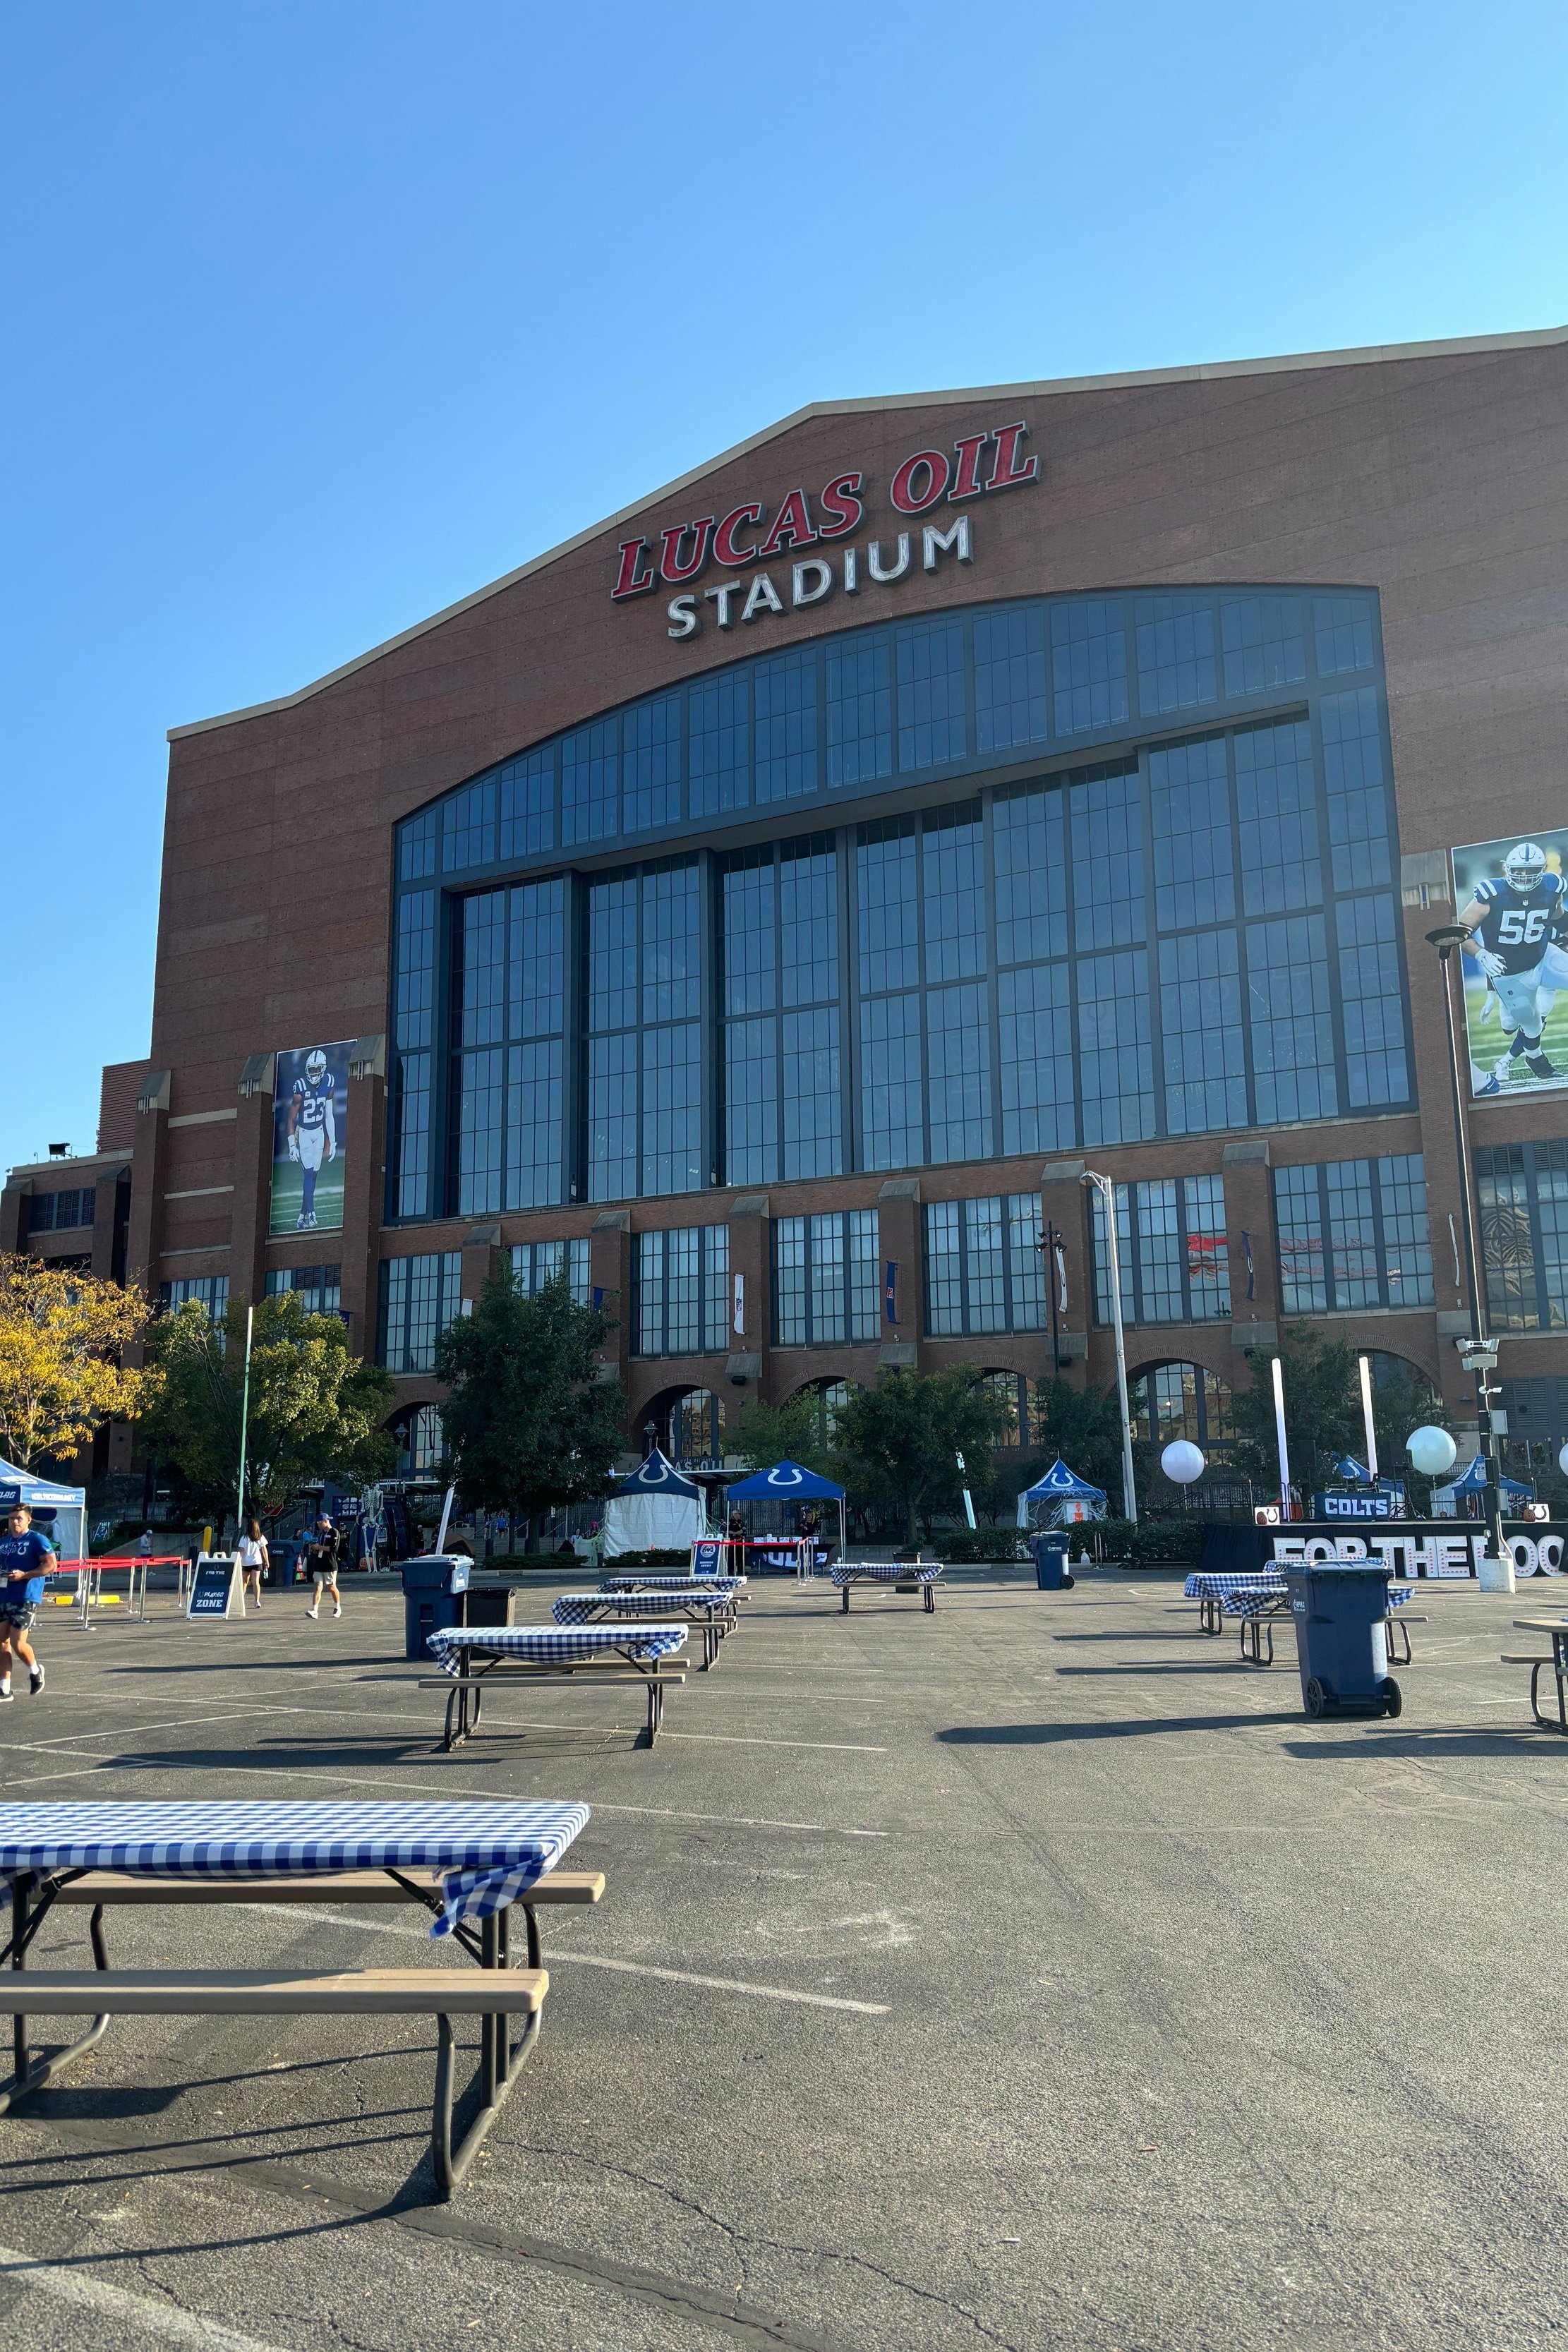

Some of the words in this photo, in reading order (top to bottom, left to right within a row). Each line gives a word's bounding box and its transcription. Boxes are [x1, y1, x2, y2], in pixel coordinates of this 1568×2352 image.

[611, 471, 867, 602] LUCAS
[891, 420, 1042, 517] OIL
[668, 515, 973, 641] STADIUM
[1498, 908, 1550, 945] 56
[303, 1097, 326, 1123] 23
[1325, 1497, 1388, 1516] COLTS
[1370, 1536, 1471, 1579] THE
[195, 1599, 224, 1608] ZONE
